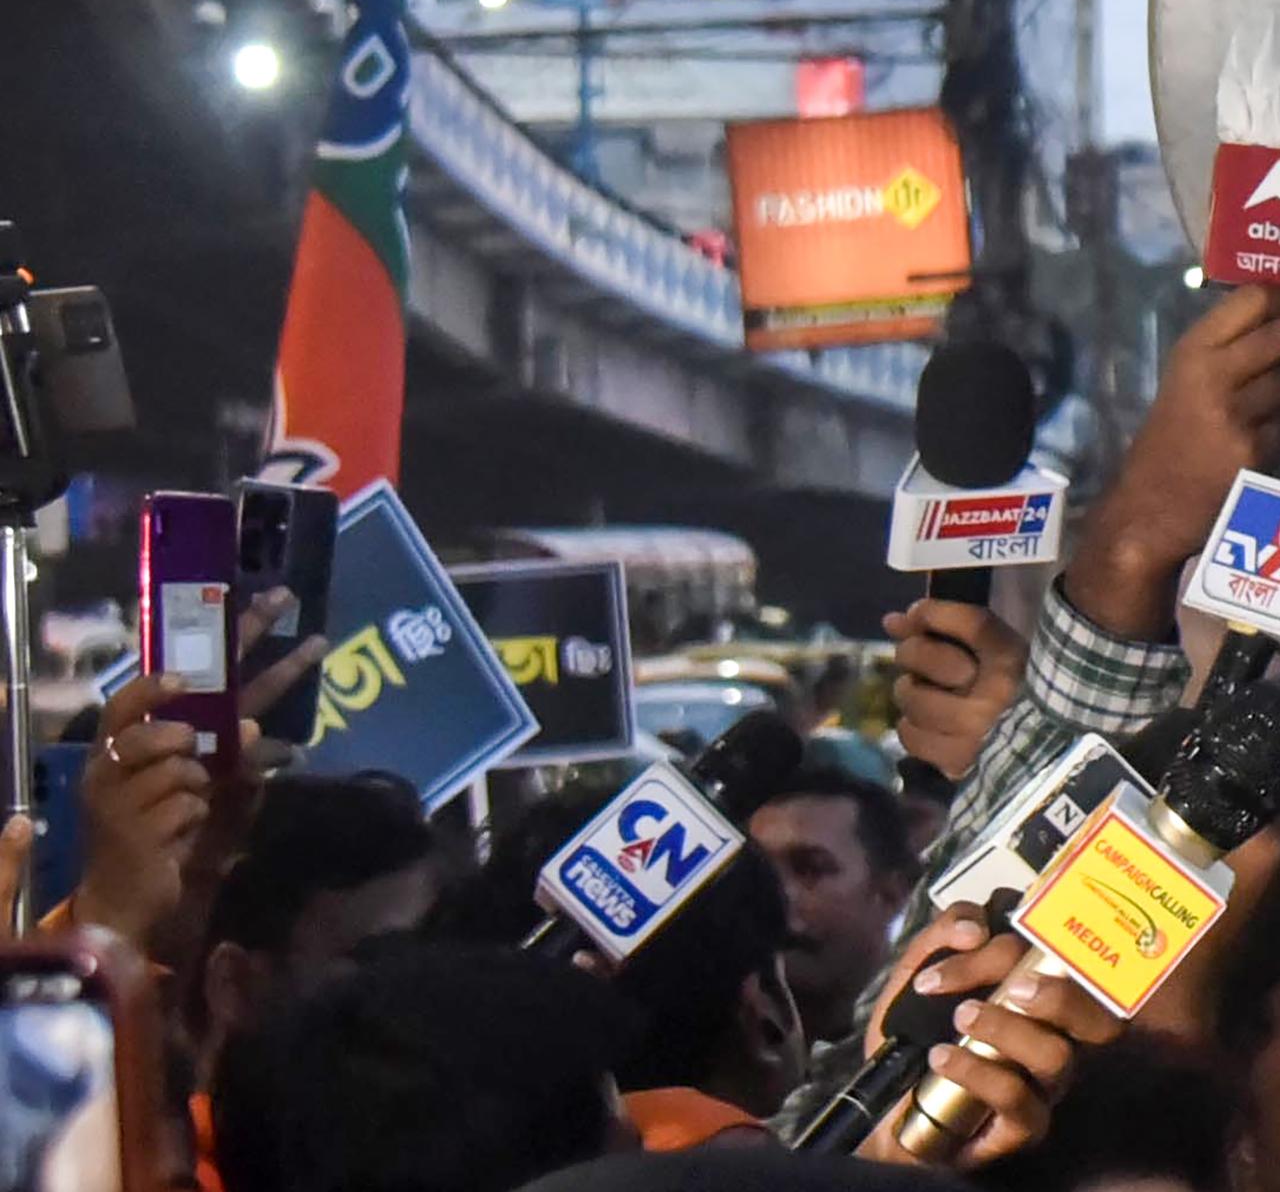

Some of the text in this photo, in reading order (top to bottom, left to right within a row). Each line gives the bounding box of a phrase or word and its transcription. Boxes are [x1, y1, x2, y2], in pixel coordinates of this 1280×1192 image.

[757, 187, 885, 227] FASHION
[942, 505, 1048, 527] JAZZBAAT 24
[967, 534, 1043, 560] বাংলা
[1228, 572, 1279, 608] বাংলা
[564, 861, 638, 930] news
[1063, 916, 1122, 968] MEDIA
